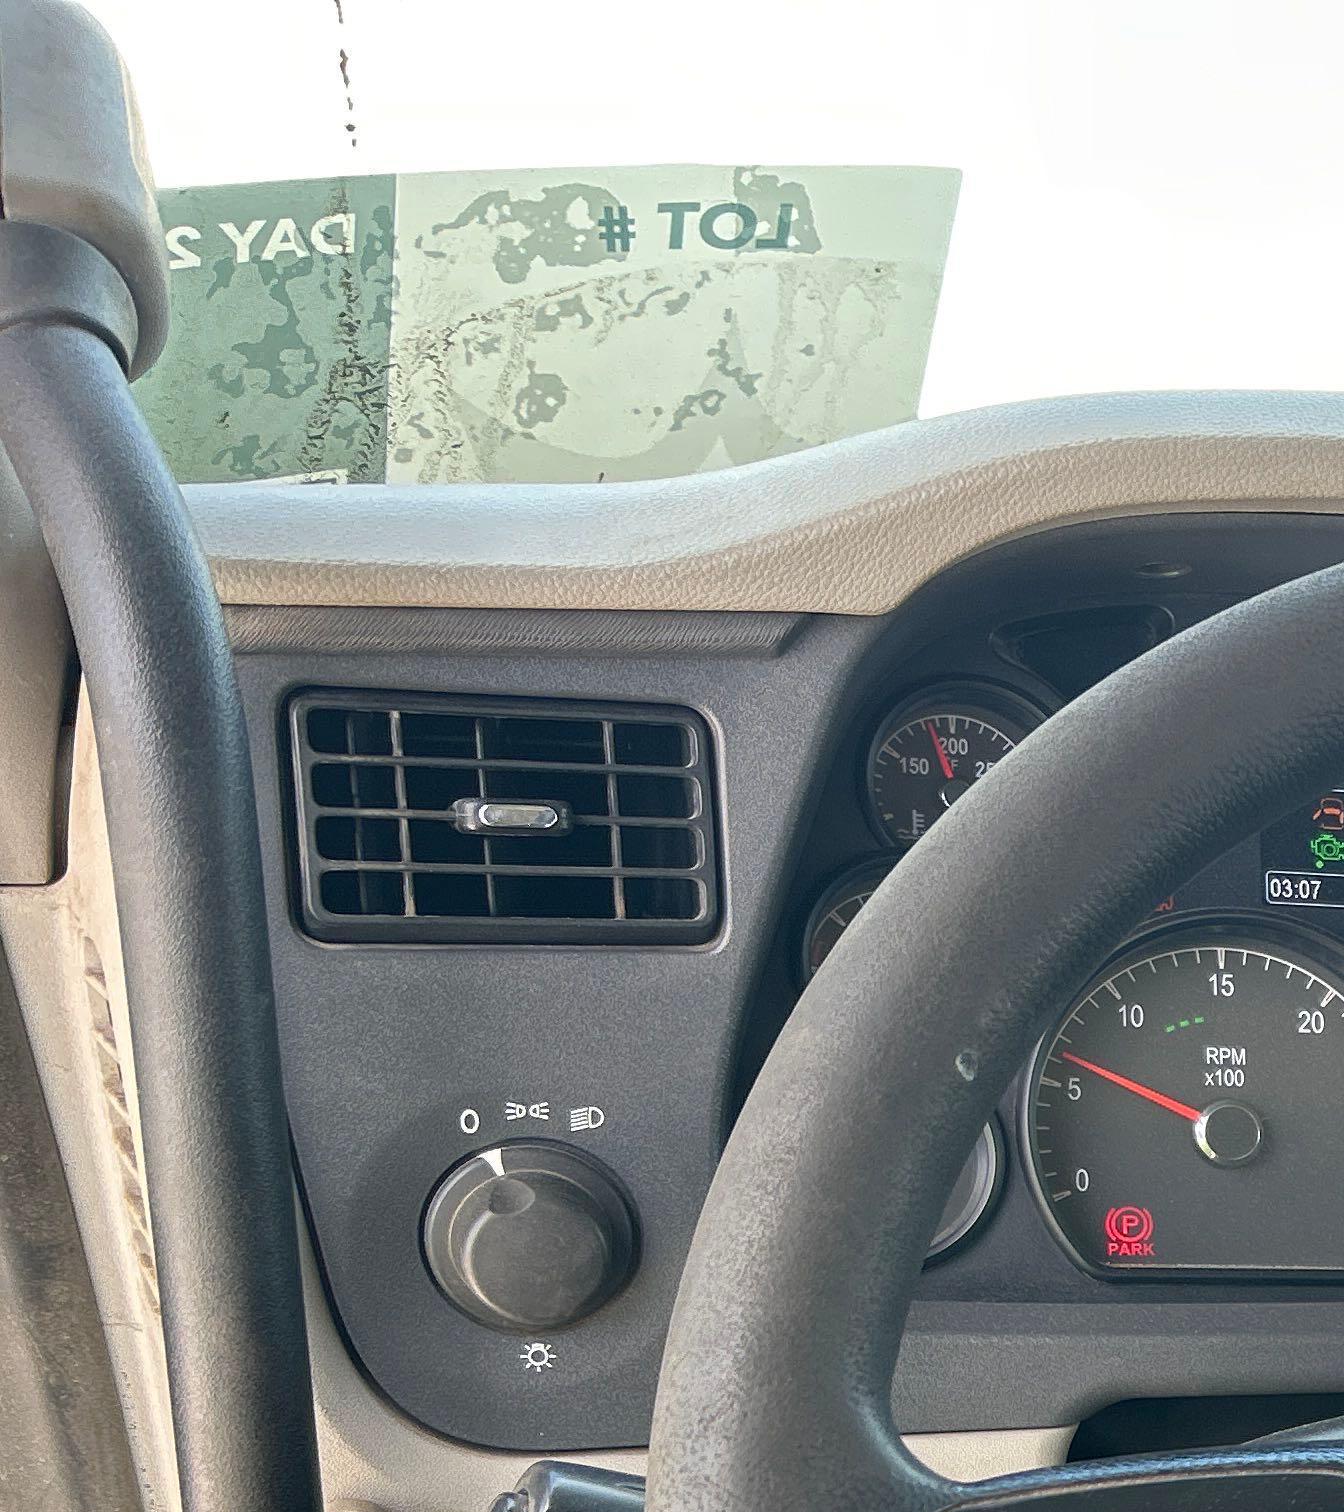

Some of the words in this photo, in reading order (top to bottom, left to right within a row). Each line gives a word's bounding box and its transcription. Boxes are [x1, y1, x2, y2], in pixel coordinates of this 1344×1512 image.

[939, 737, 969, 755] 200
[900, 757, 930, 775] 150
[1269, 877, 1322, 901] 03:07
[1209, 974, 1235, 997] 15
[1118, 1004, 1144, 1029] 10
[1298, 1010, 1325, 1035] 20
[1206, 1046, 1247, 1066] RPM
[1204, 1068, 1245, 1087] x100
[1067, 1078, 1082, 1101] 5
[1075, 1169, 1090, 1193] 0
[1107, 1242, 1155, 1256] PARK
